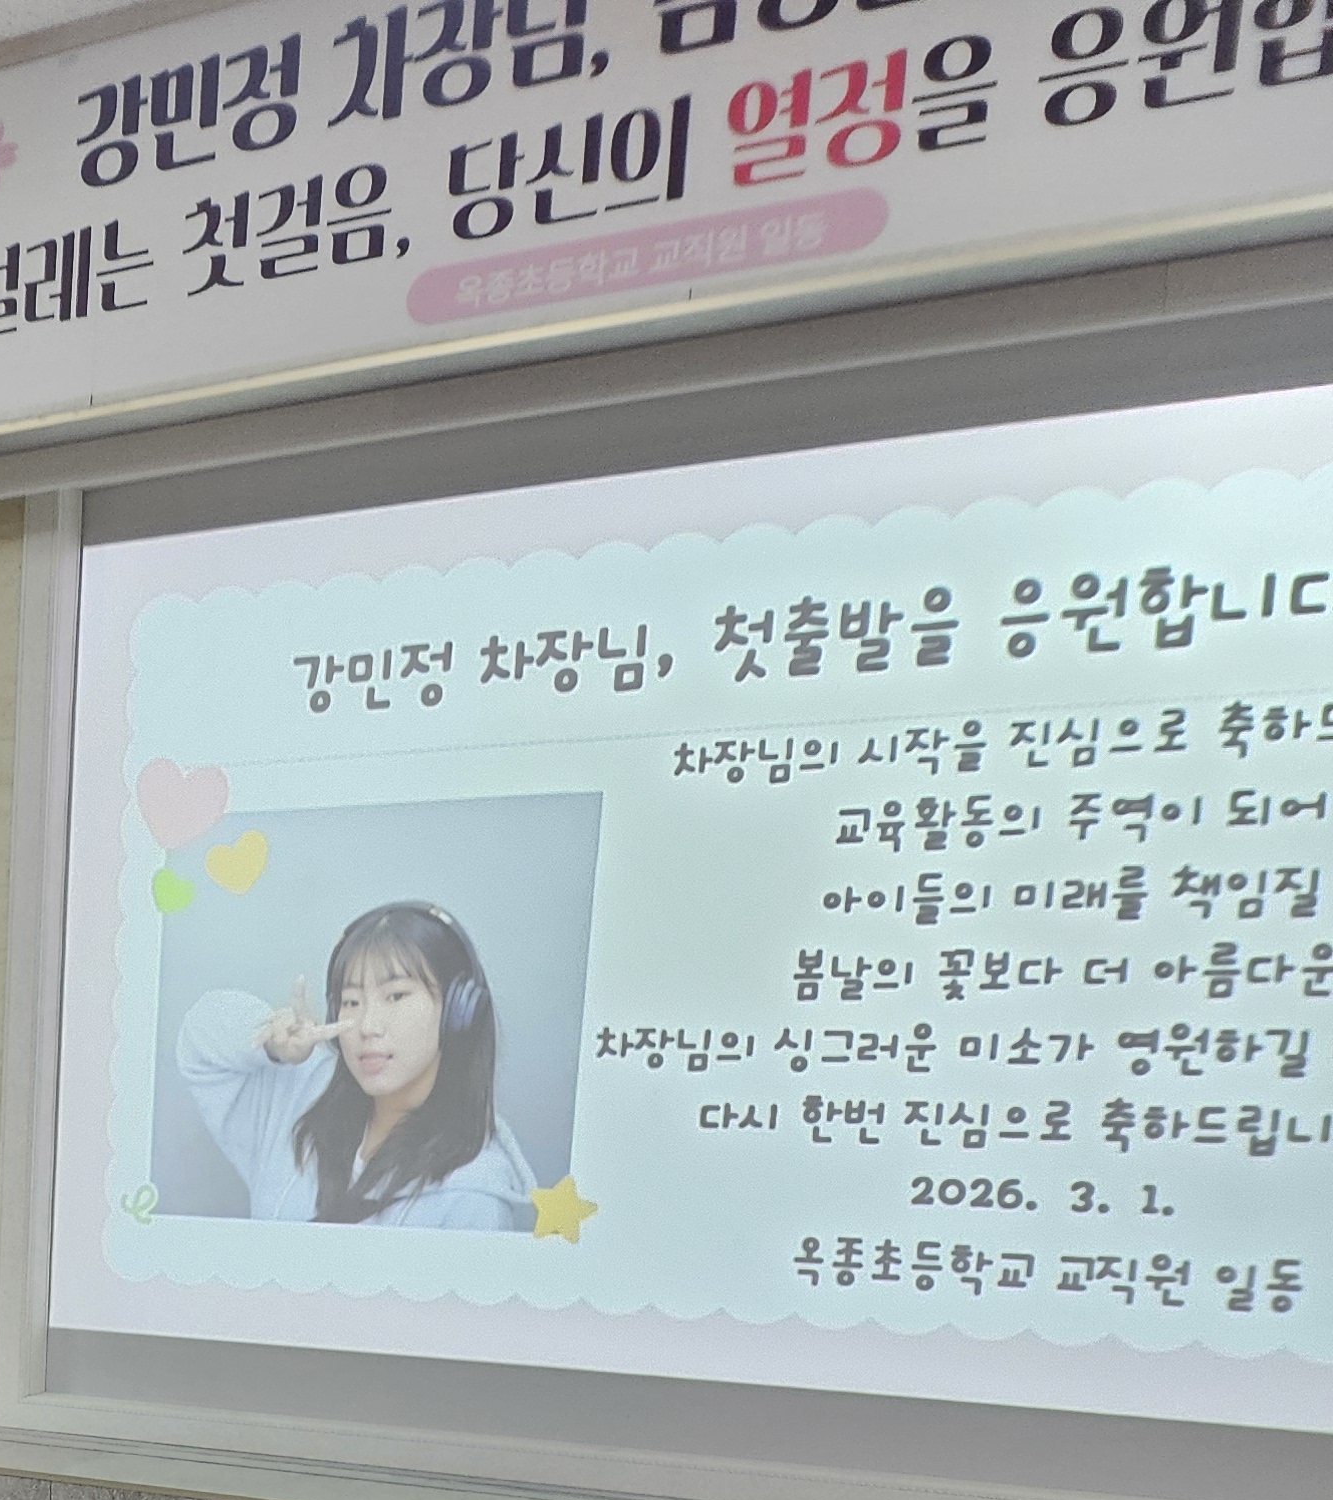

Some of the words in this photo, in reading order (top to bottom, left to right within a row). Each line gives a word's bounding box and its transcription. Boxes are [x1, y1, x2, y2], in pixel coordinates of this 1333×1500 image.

[77, 33, 301, 187] 강민정
[328, 0, 609, 128] 차장님,
[183, 163, 410, 297] 첫걸음,
[448, 95, 691, 240] 당신의
[727, 34, 998, 187] 열정을
[456, 249, 639, 306] 옥종초등학교
[649, 226, 746, 275] 교직원
[761, 208, 827, 255] 일동
[294, 641, 453, 713] 강민정
[480, 624, 673, 692] 차장님,
[715, 587, 959, 682] 첫출발을
[674, 738, 838, 784] 차장님의
[856, 720, 987, 775] 시작을
[1009, 708, 1187, 768] 진심으로
[836, 795, 1041, 853] 교육활동의
[1069, 793, 1203, 843] 주역이
[1226, 789, 1328, 827] 되어
[823, 873, 991, 925] 아이들의
[1014, 866, 1148, 920] 미래를
[1171, 864, 1320, 919] 책임질
[793, 949, 913, 1001] 봄날의
[939, 949, 1063, 1000] 꽃보다
[1084, 957, 1128, 984] 더
[1154, 942, 1333, 999] 아름다운
[597, 1027, 754, 1072] 차장님의
[774, 1023, 937, 1073] 싱그러운
[960, 1027, 1094, 1065] 미소가
[1118, 1024, 1310, 1078] 영원하길
[700, 1103, 777, 1130] 다시
[803, 1095, 885, 1144] 한번
[904, 1101, 1072, 1148] 진심으로
[911, 1176, 1037, 1211] 2026.
[1071, 1181, 1110, 1214] 3.
[1142, 1185, 1174, 1216] 1.
[793, 1237, 1035, 1296] 옥종초등학교
[1057, 1254, 1190, 1307] 교직원
[1216, 1259, 1302, 1313] 일동
